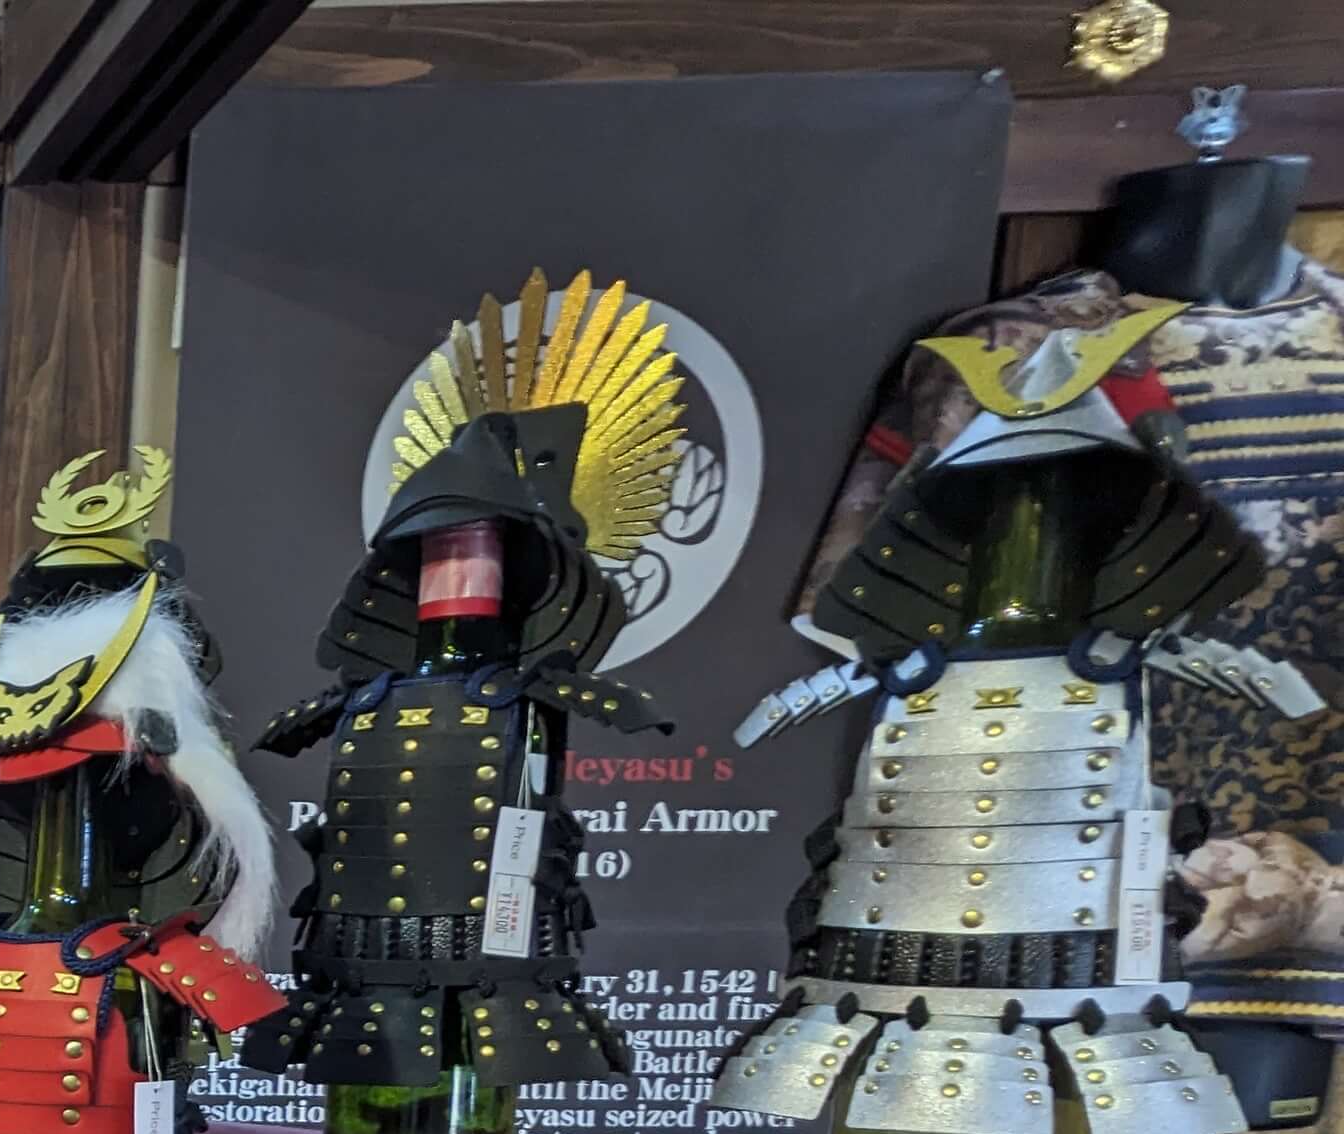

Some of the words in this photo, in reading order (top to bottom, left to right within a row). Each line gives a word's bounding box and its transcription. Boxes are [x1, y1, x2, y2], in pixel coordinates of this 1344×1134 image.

[640, 800, 778, 832] Armor
[509, 825, 527, 860] Price
[680, 969, 757, 993] 1542
[657, 997, 721, 1020] and
[727, 996, 783, 1020] firs
[633, 1051, 721, 1075] Battle
[188, 1072, 328, 1099] ekigahar
[577, 1080, 629, 1101] the
[636, 1076, 712, 1104] Meiji
[198, 1099, 326, 1123] estoratio
[514, 1108, 596, 1132] eyasu
[605, 1104, 696, 1128] seized
